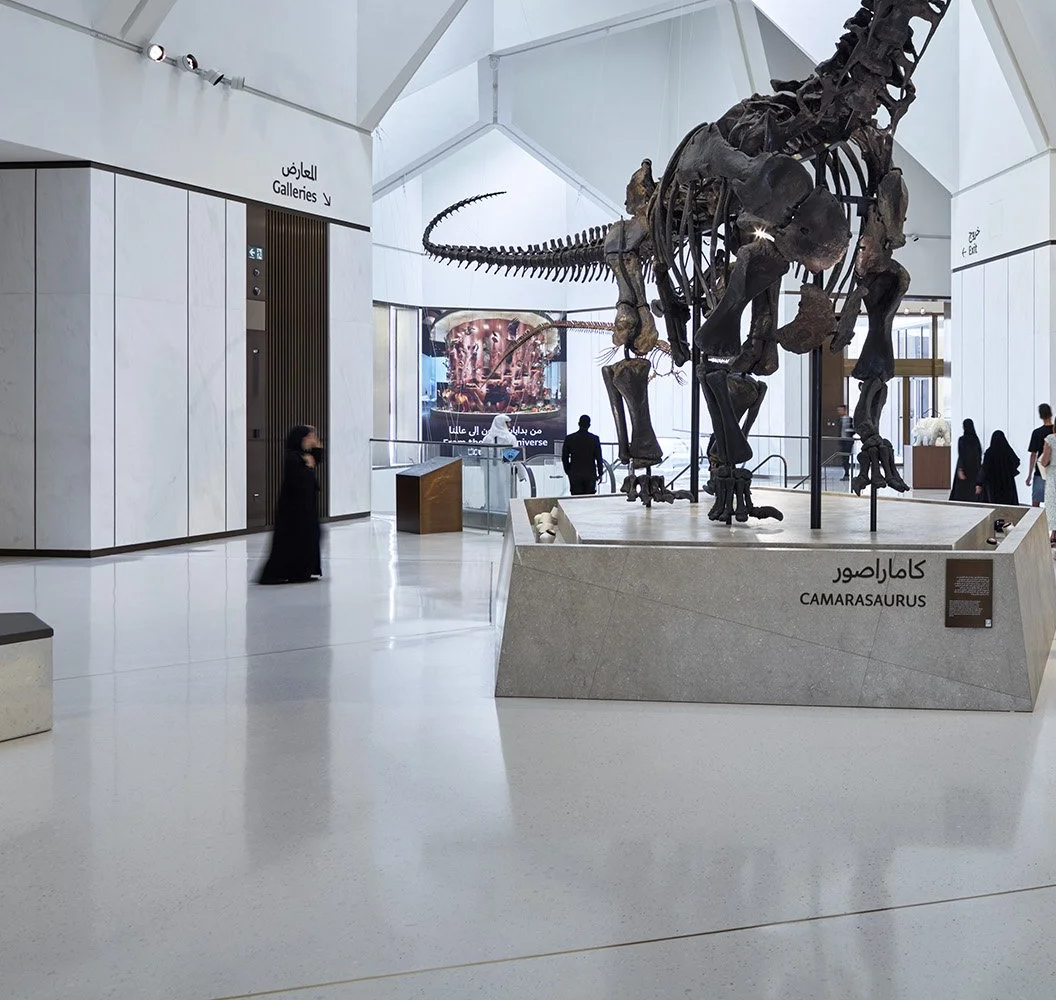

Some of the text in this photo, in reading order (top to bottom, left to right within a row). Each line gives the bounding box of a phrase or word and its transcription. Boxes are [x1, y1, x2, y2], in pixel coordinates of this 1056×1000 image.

[281, 161, 317, 181] المعارض
[272, 180, 317, 203] Galleries
[969, 243, 978, 255] Exit
[529, 428, 542, 436] من
[516, 438, 548, 447] niverse
[832, 558, 926, 584] كاماراصور
[800, 592, 926, 608] CAMARASAURUS
